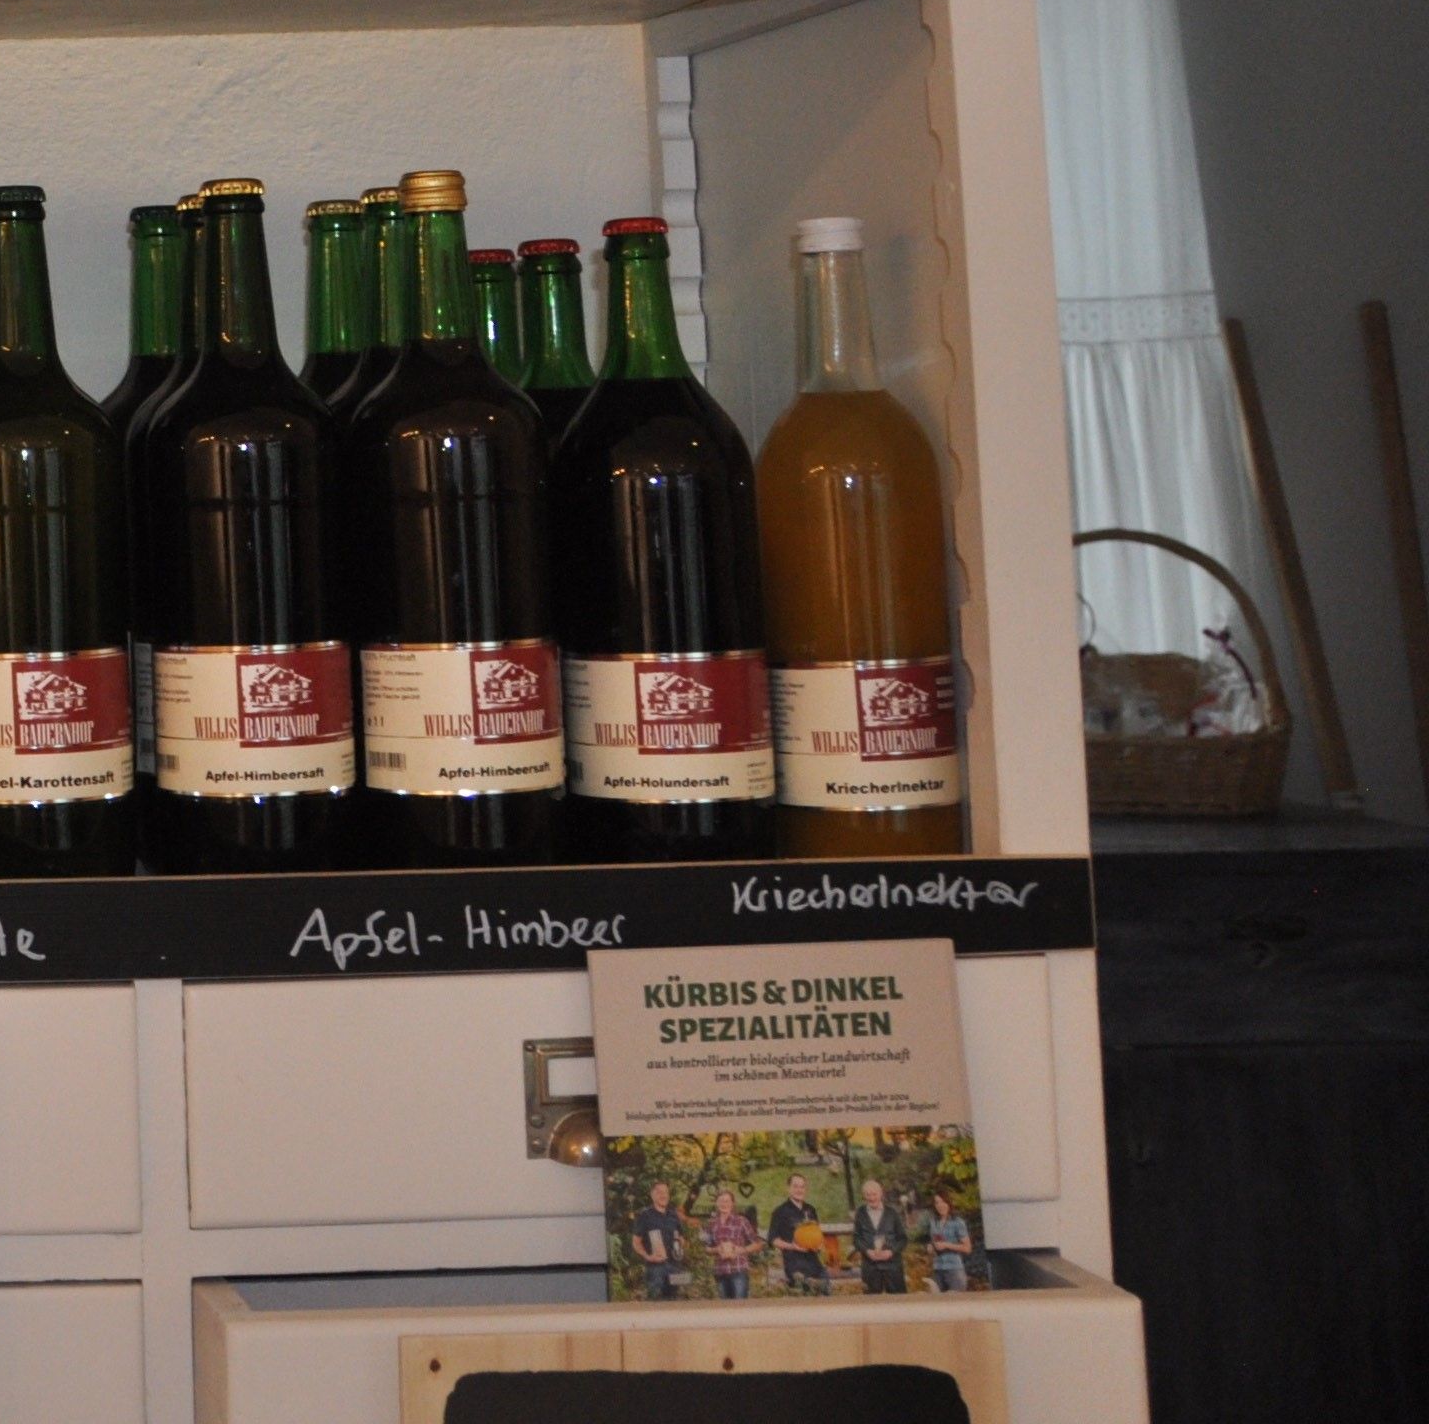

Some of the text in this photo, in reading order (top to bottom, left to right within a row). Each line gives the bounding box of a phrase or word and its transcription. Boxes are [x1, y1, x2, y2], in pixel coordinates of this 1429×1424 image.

[20, 721, 94, 746] BAUERNHOF
[194, 714, 319, 739] WILLIS BAUERNHOF
[424, 709, 545, 736] WILLIS BAUERNHOF
[595, 723, 721, 746] WILLIS BAUERNHOF
[811, 727, 938, 753] WILLIS BAUERNHOF
[206, 767, 324, 783] Apfel-Himbeersaft
[439, 762, 550, 780] Apfel-Himbeersaft
[604, 776, 729, 788] Apfel-Holundersaft
[826, 780, 944, 794] Kriecherlnektar
[732, 874, 1038, 914] Kriecherlnektar
[643, 975, 903, 1009] KÜRBIS & DINKEL
[660, 1005, 892, 1044] SPEZIALITÄTEN
[646, 1047, 911, 1070] aus kontrollierter biologischer Landwirtschaft
[715, 1071, 730, 1082] im
[733, 1068, 778, 1082] schönen
